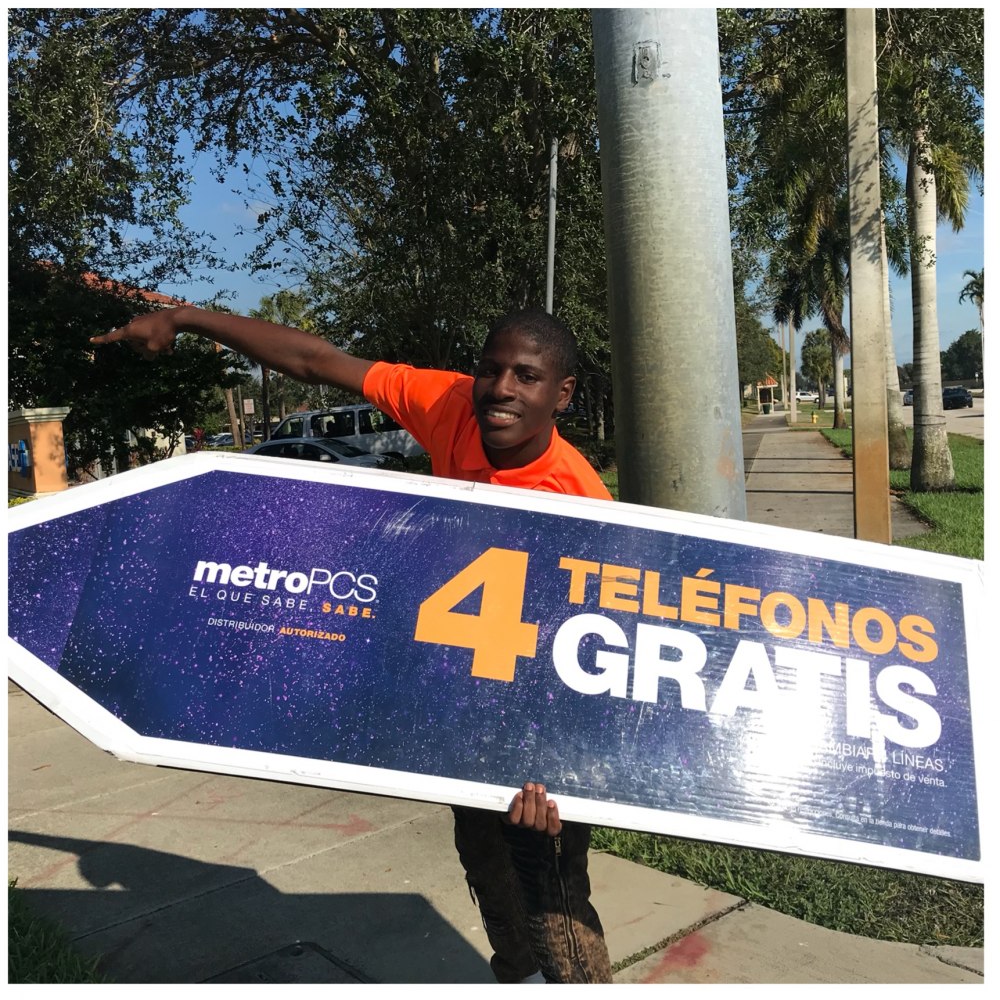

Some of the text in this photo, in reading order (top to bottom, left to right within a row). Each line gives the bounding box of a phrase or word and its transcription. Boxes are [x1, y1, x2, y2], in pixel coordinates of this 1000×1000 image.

[193, 560, 379, 603] metroPCS
[189, 586, 208, 598] EL
[217, 589, 254, 603] QUE
[322, 602, 376, 619] SABE.
[414, 547, 940, 682] 4 TELÉFONOS
[207, 617, 346, 642] DISTRIBUIDOR AUTORIZADO
[552, 613, 942, 749] GRATIS
[893, 749, 948, 773] LÍNEAS.
[903, 771, 916, 781] de
[917, 775, 948, 787] venta.
[893, 822, 907, 831] para
[907, 823, 929, 834] obtener
